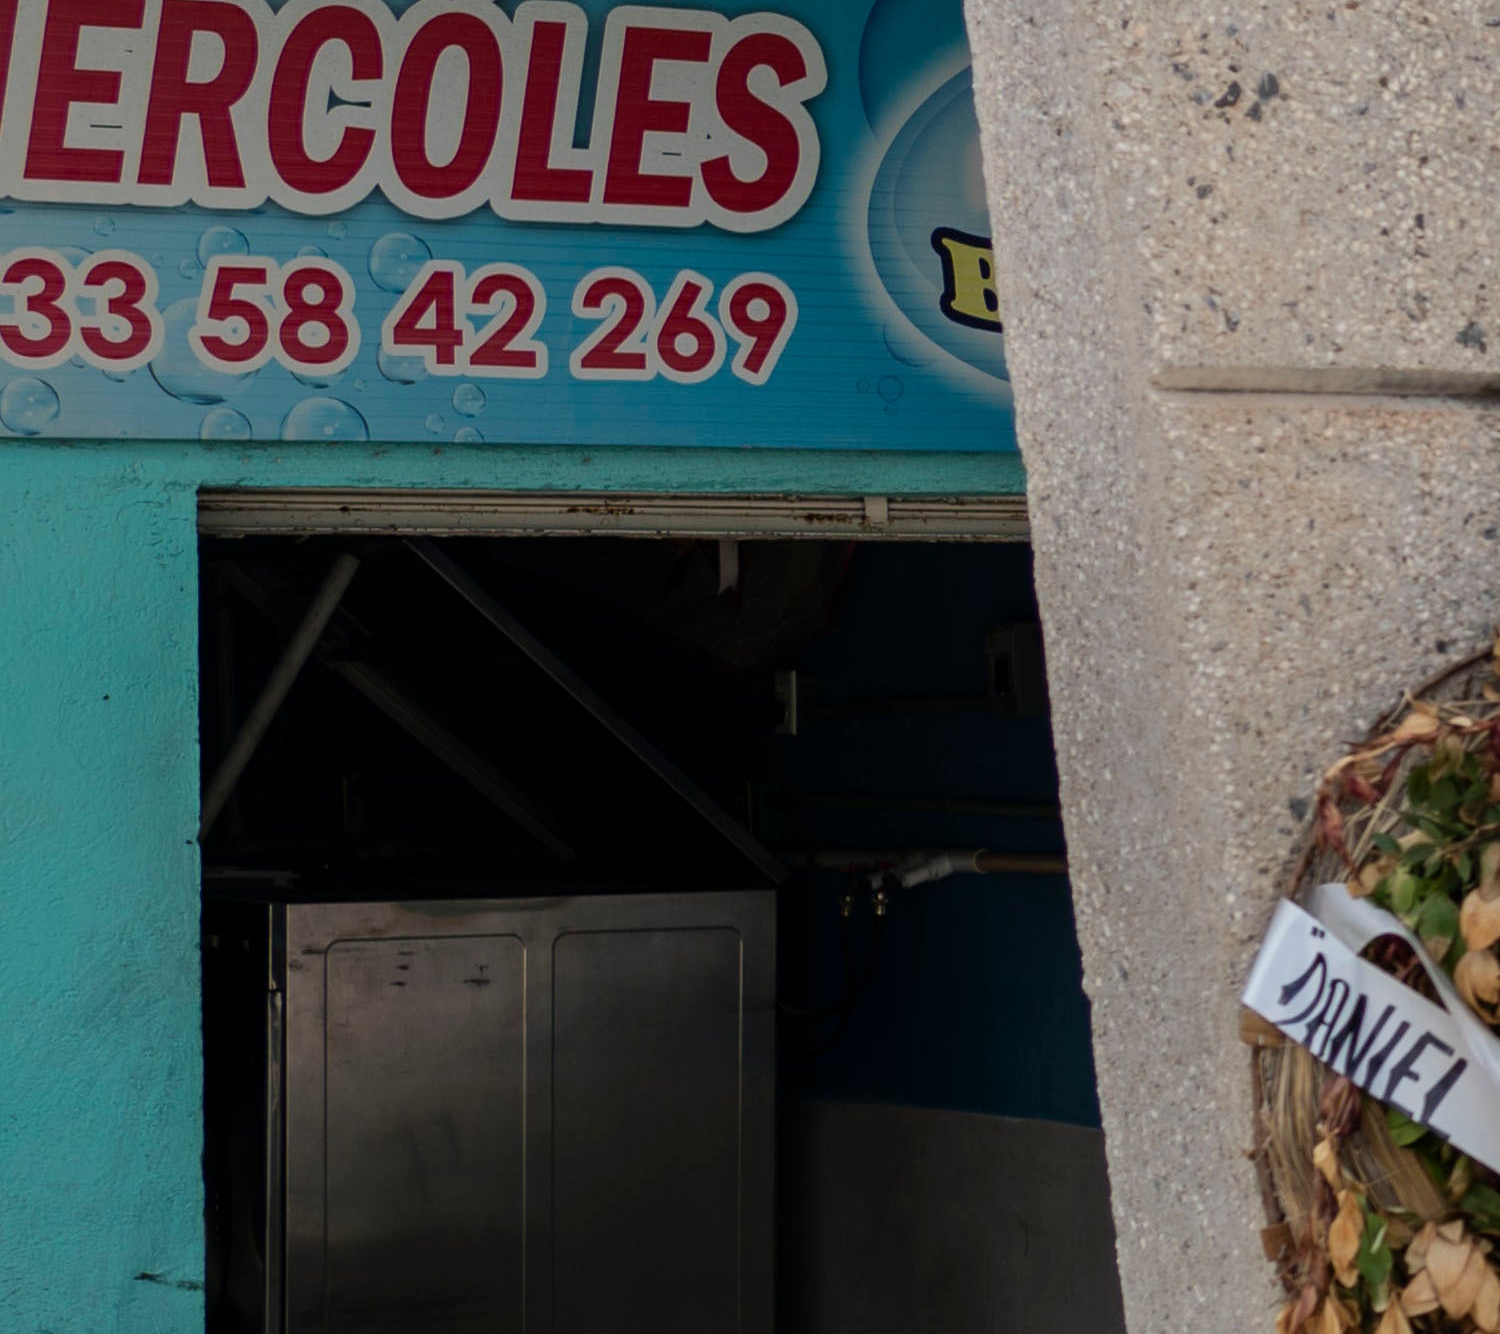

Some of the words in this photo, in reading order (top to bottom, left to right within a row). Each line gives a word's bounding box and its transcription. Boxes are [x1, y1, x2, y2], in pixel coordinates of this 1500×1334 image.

[0, 258, 152, 360] 33
[200, 267, 349, 364] 58
[392, 270, 538, 368] 42
[580, 277, 787, 375] 269
